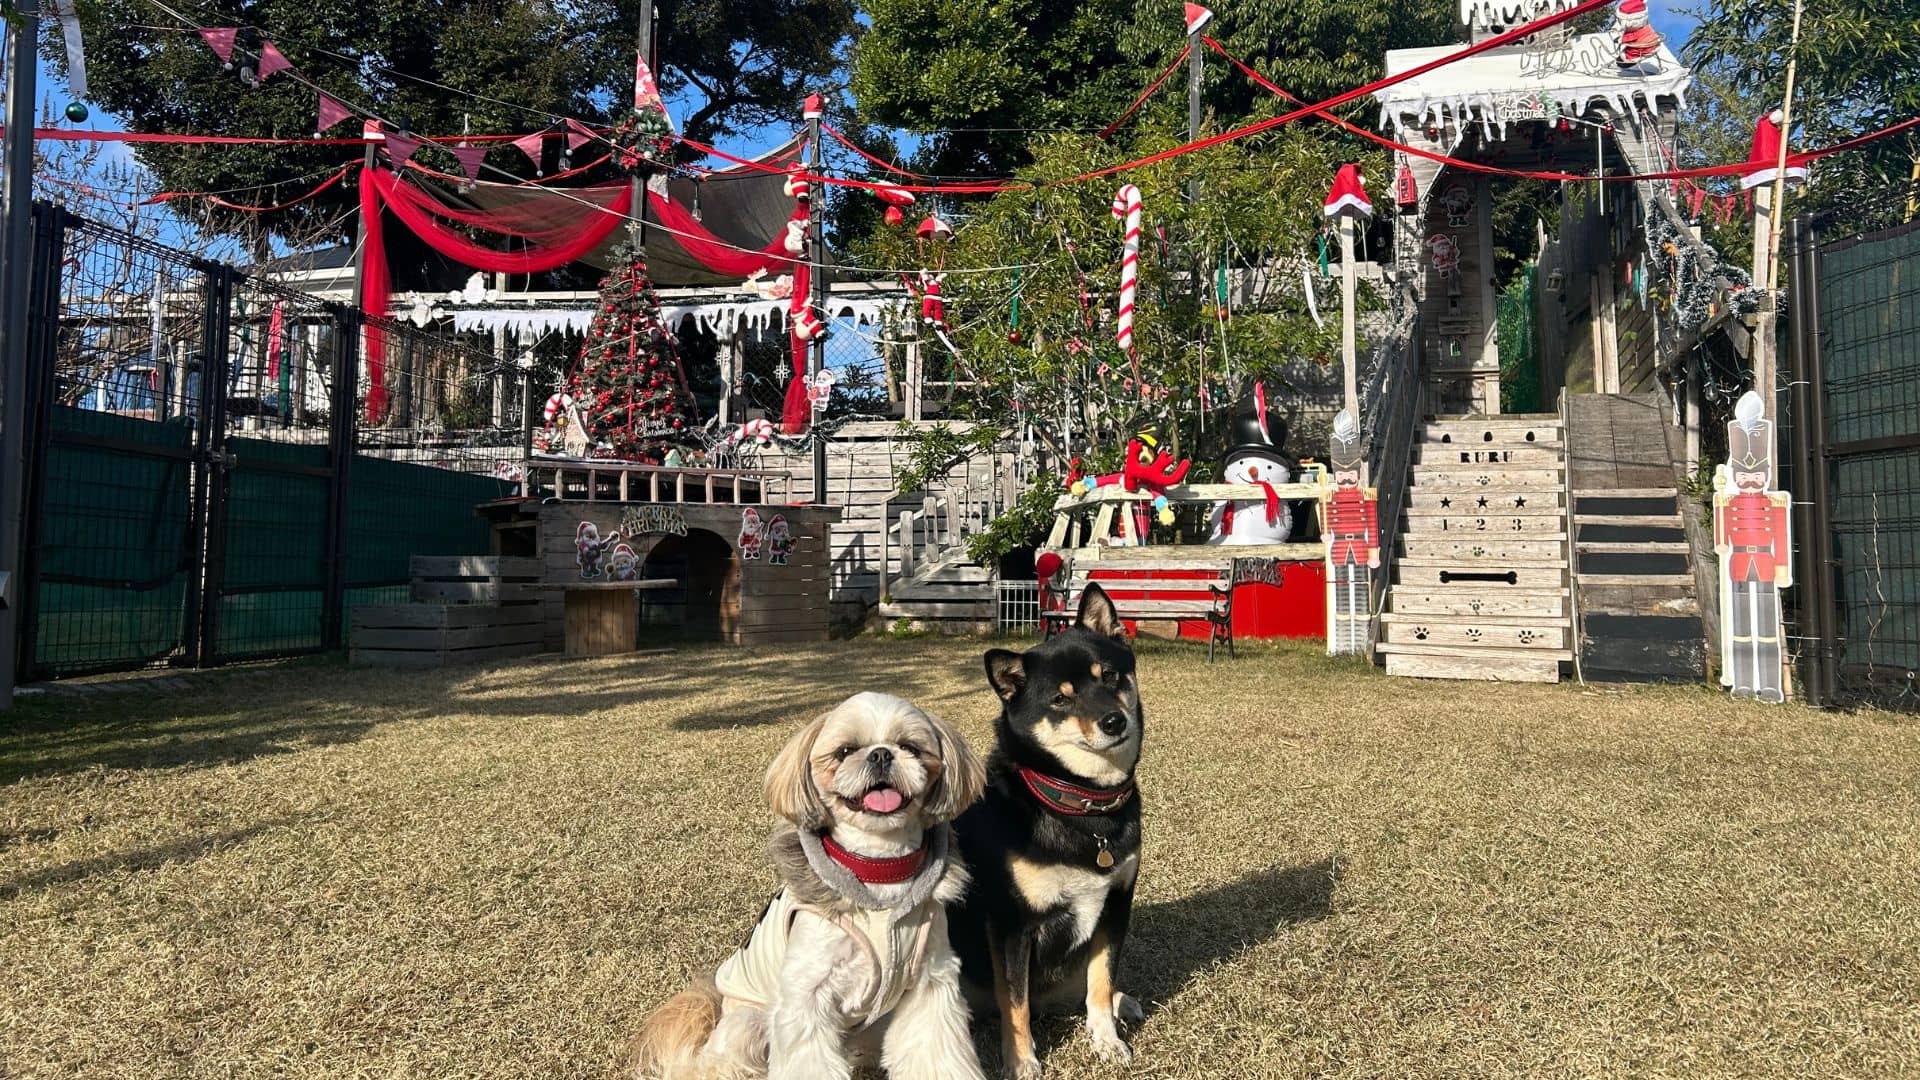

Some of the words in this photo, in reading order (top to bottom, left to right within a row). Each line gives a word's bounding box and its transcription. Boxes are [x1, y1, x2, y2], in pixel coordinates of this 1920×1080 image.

[620, 517, 689, 538] CHRISTMAS
[1477, 519, 1486, 531] 2
[1512, 519, 1522, 531] 3
